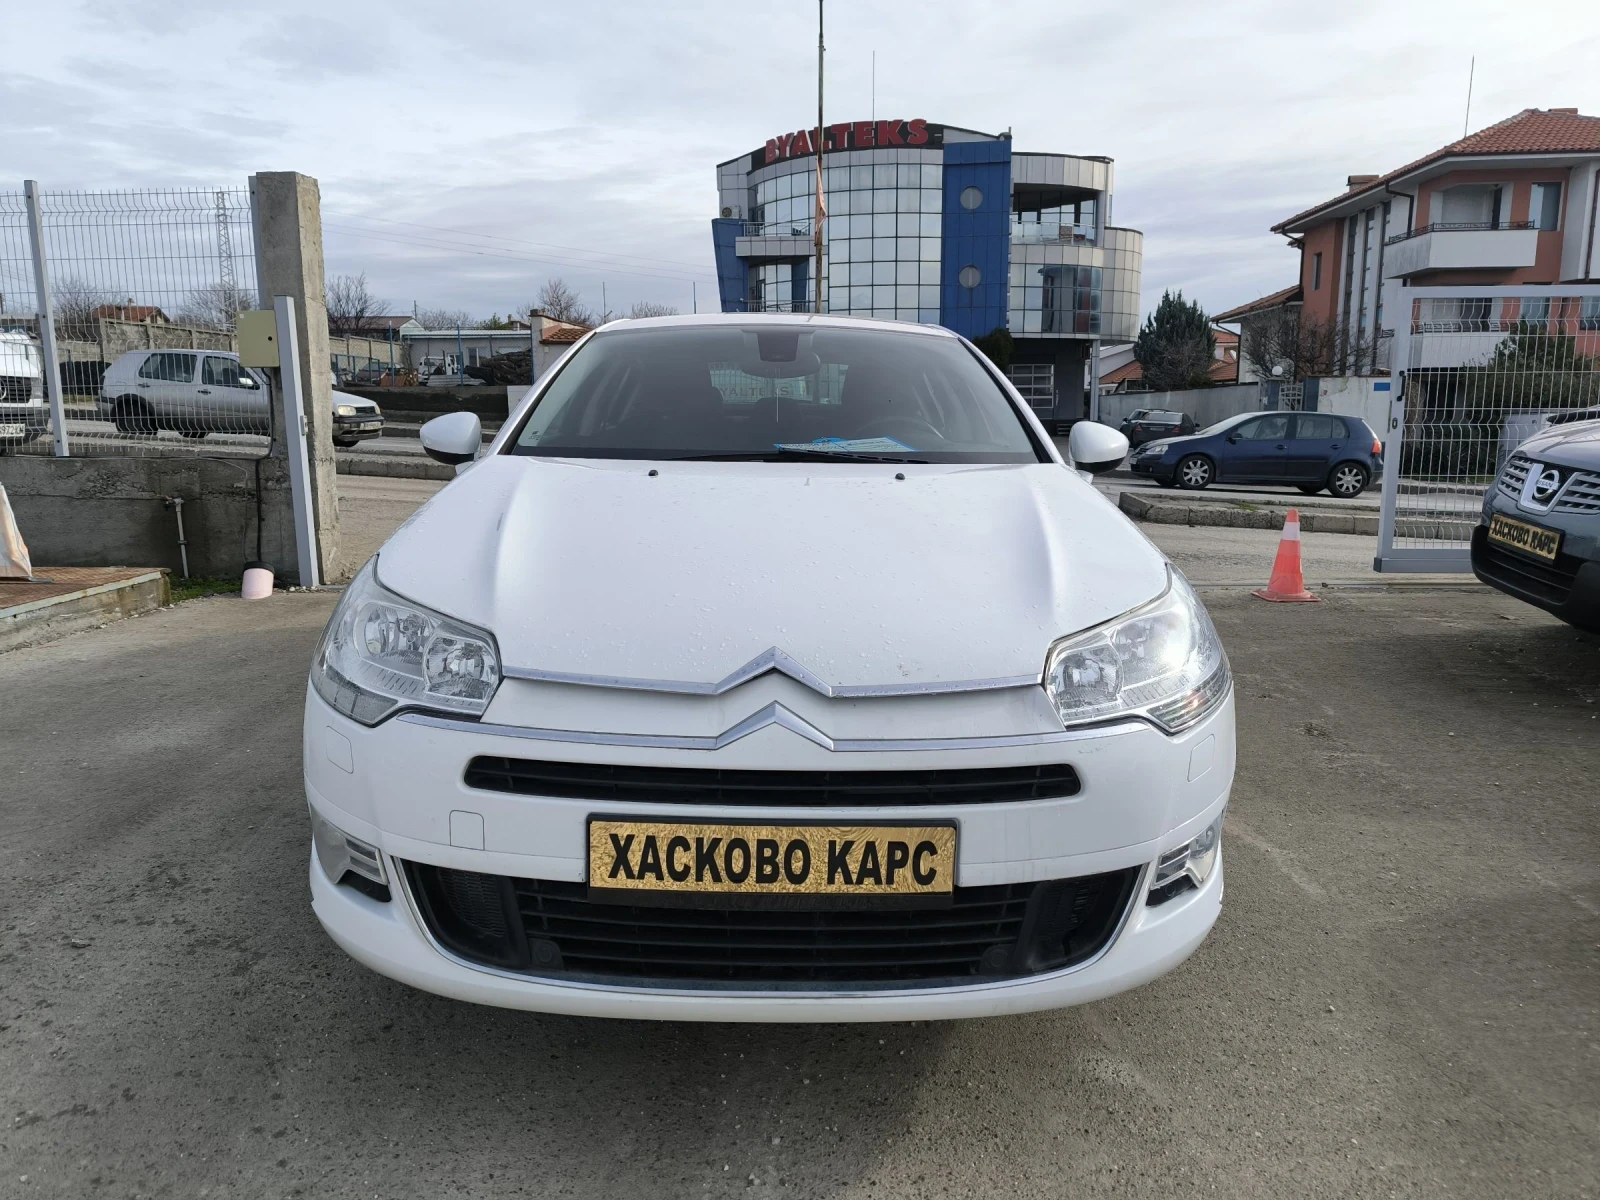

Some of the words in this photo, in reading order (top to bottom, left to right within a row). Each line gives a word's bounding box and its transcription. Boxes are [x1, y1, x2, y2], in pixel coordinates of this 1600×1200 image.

[765, 118, 929, 163] BYALTEKS
[1492, 517, 1530, 546] ХАСКОВО
[1529, 530, 1556, 554] КАРС
[608, 833, 812, 885] ХАСКОВО
[826, 840, 939, 885] КАРС
